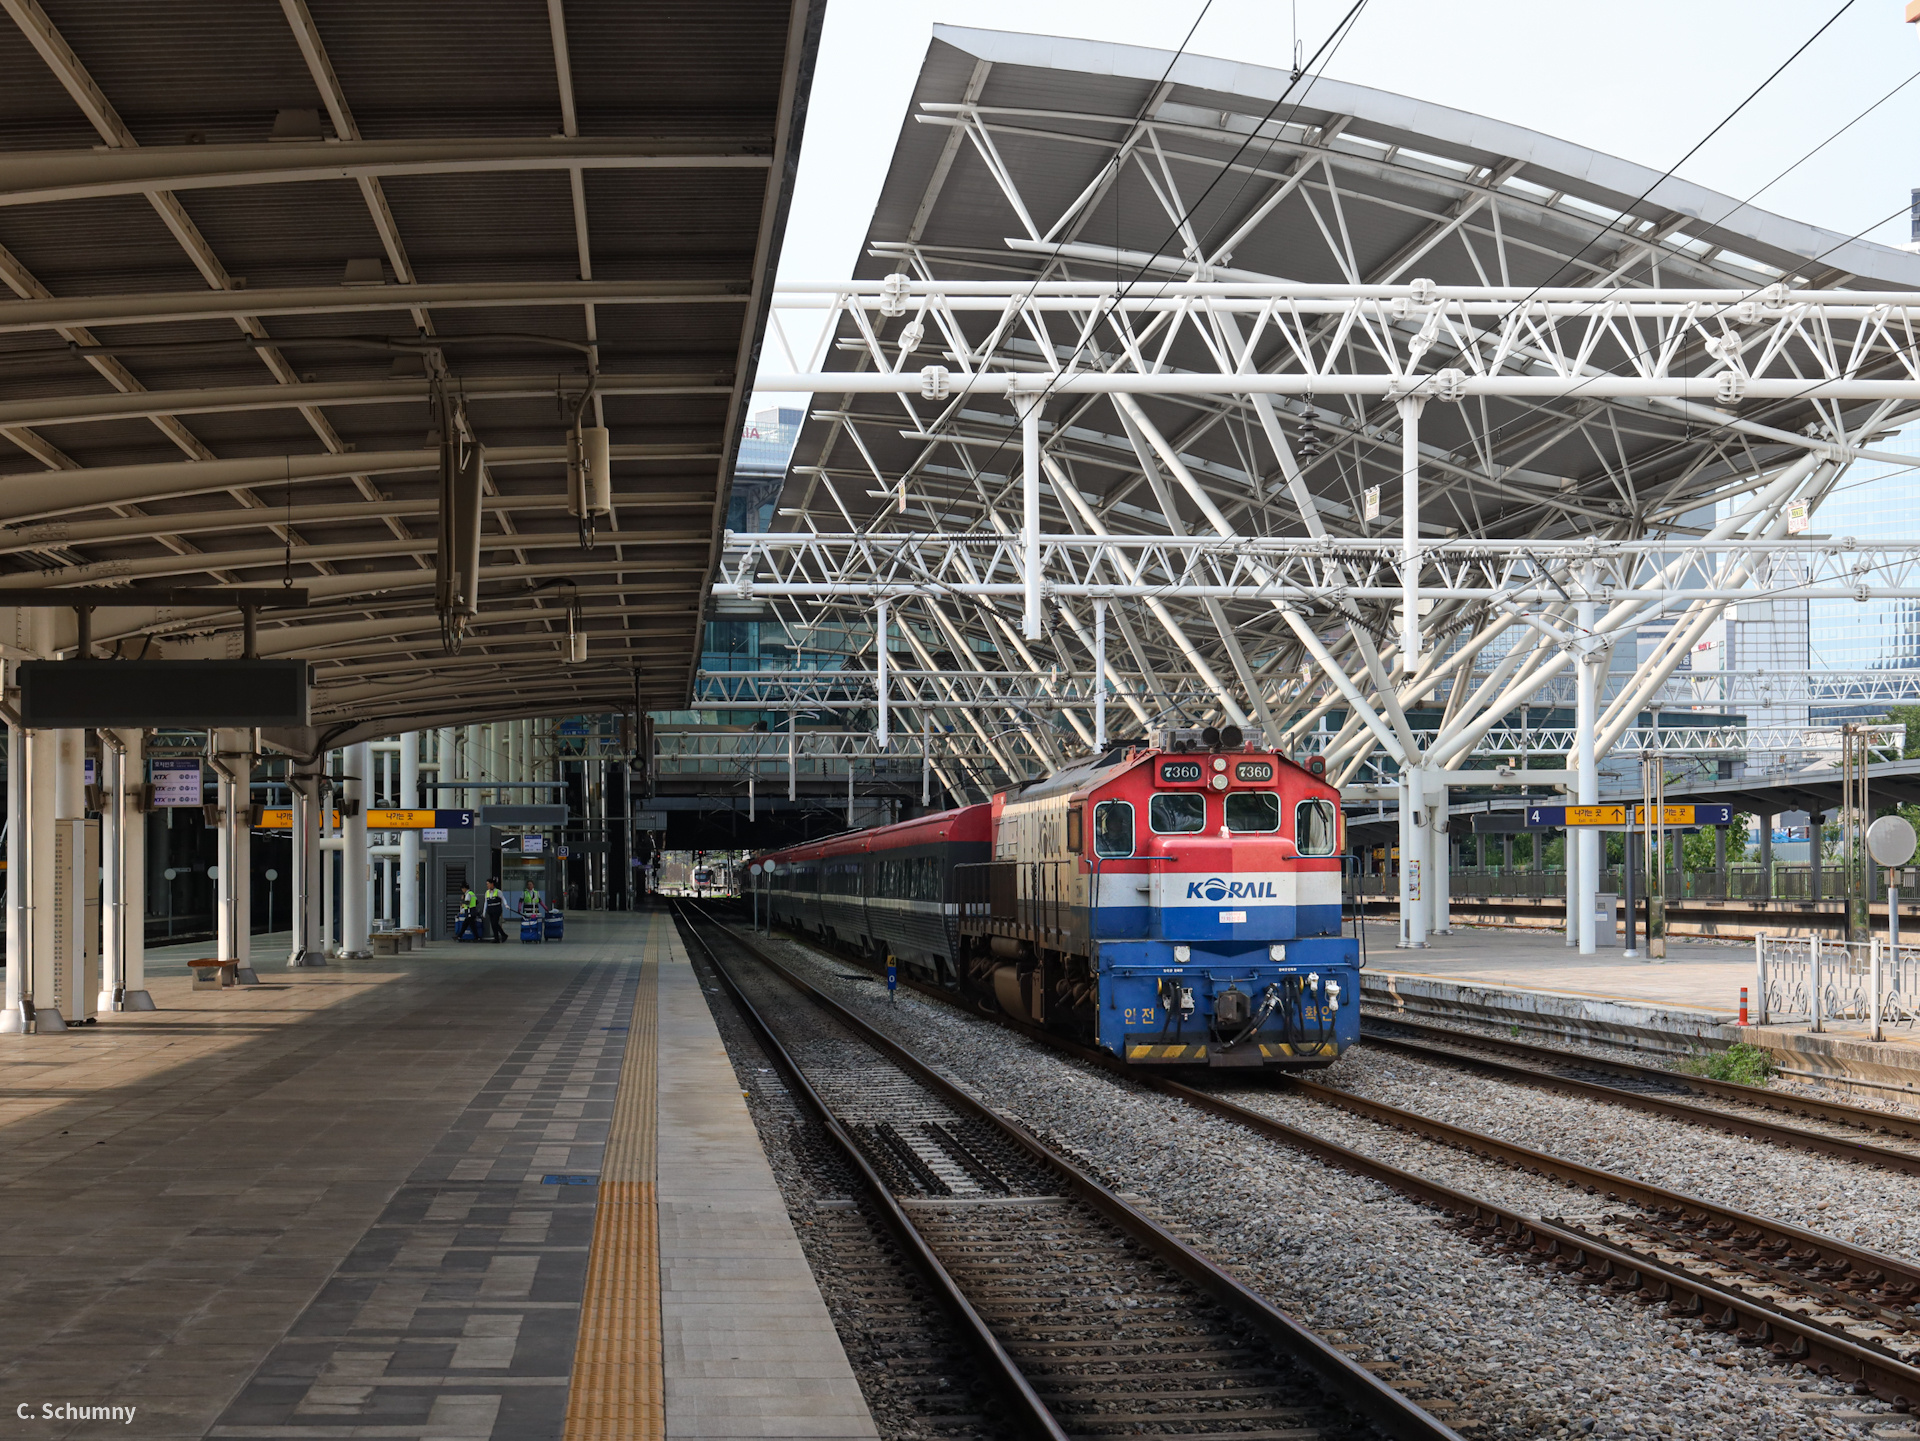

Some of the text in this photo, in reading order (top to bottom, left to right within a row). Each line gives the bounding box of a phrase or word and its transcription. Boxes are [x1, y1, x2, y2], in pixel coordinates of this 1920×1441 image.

[1164, 766, 1199, 778] 7360
[1239, 766, 1271, 778] 7360
[386, 812, 414, 821] 나가는 곳
[1531, 810, 1541, 823] 4
[1574, 808, 1602, 817] 나가는 곳
[1663, 808, 1686, 817] 가는 곳
[1720, 808, 1729, 822] 3
[461, 813, 470, 825] 5
[543, 840, 549, 848] 5
[1186, 878, 1277, 901] KORAIL
[889, 956, 895, 966] 4
[1124, 1008, 1155, 1025] 안전
